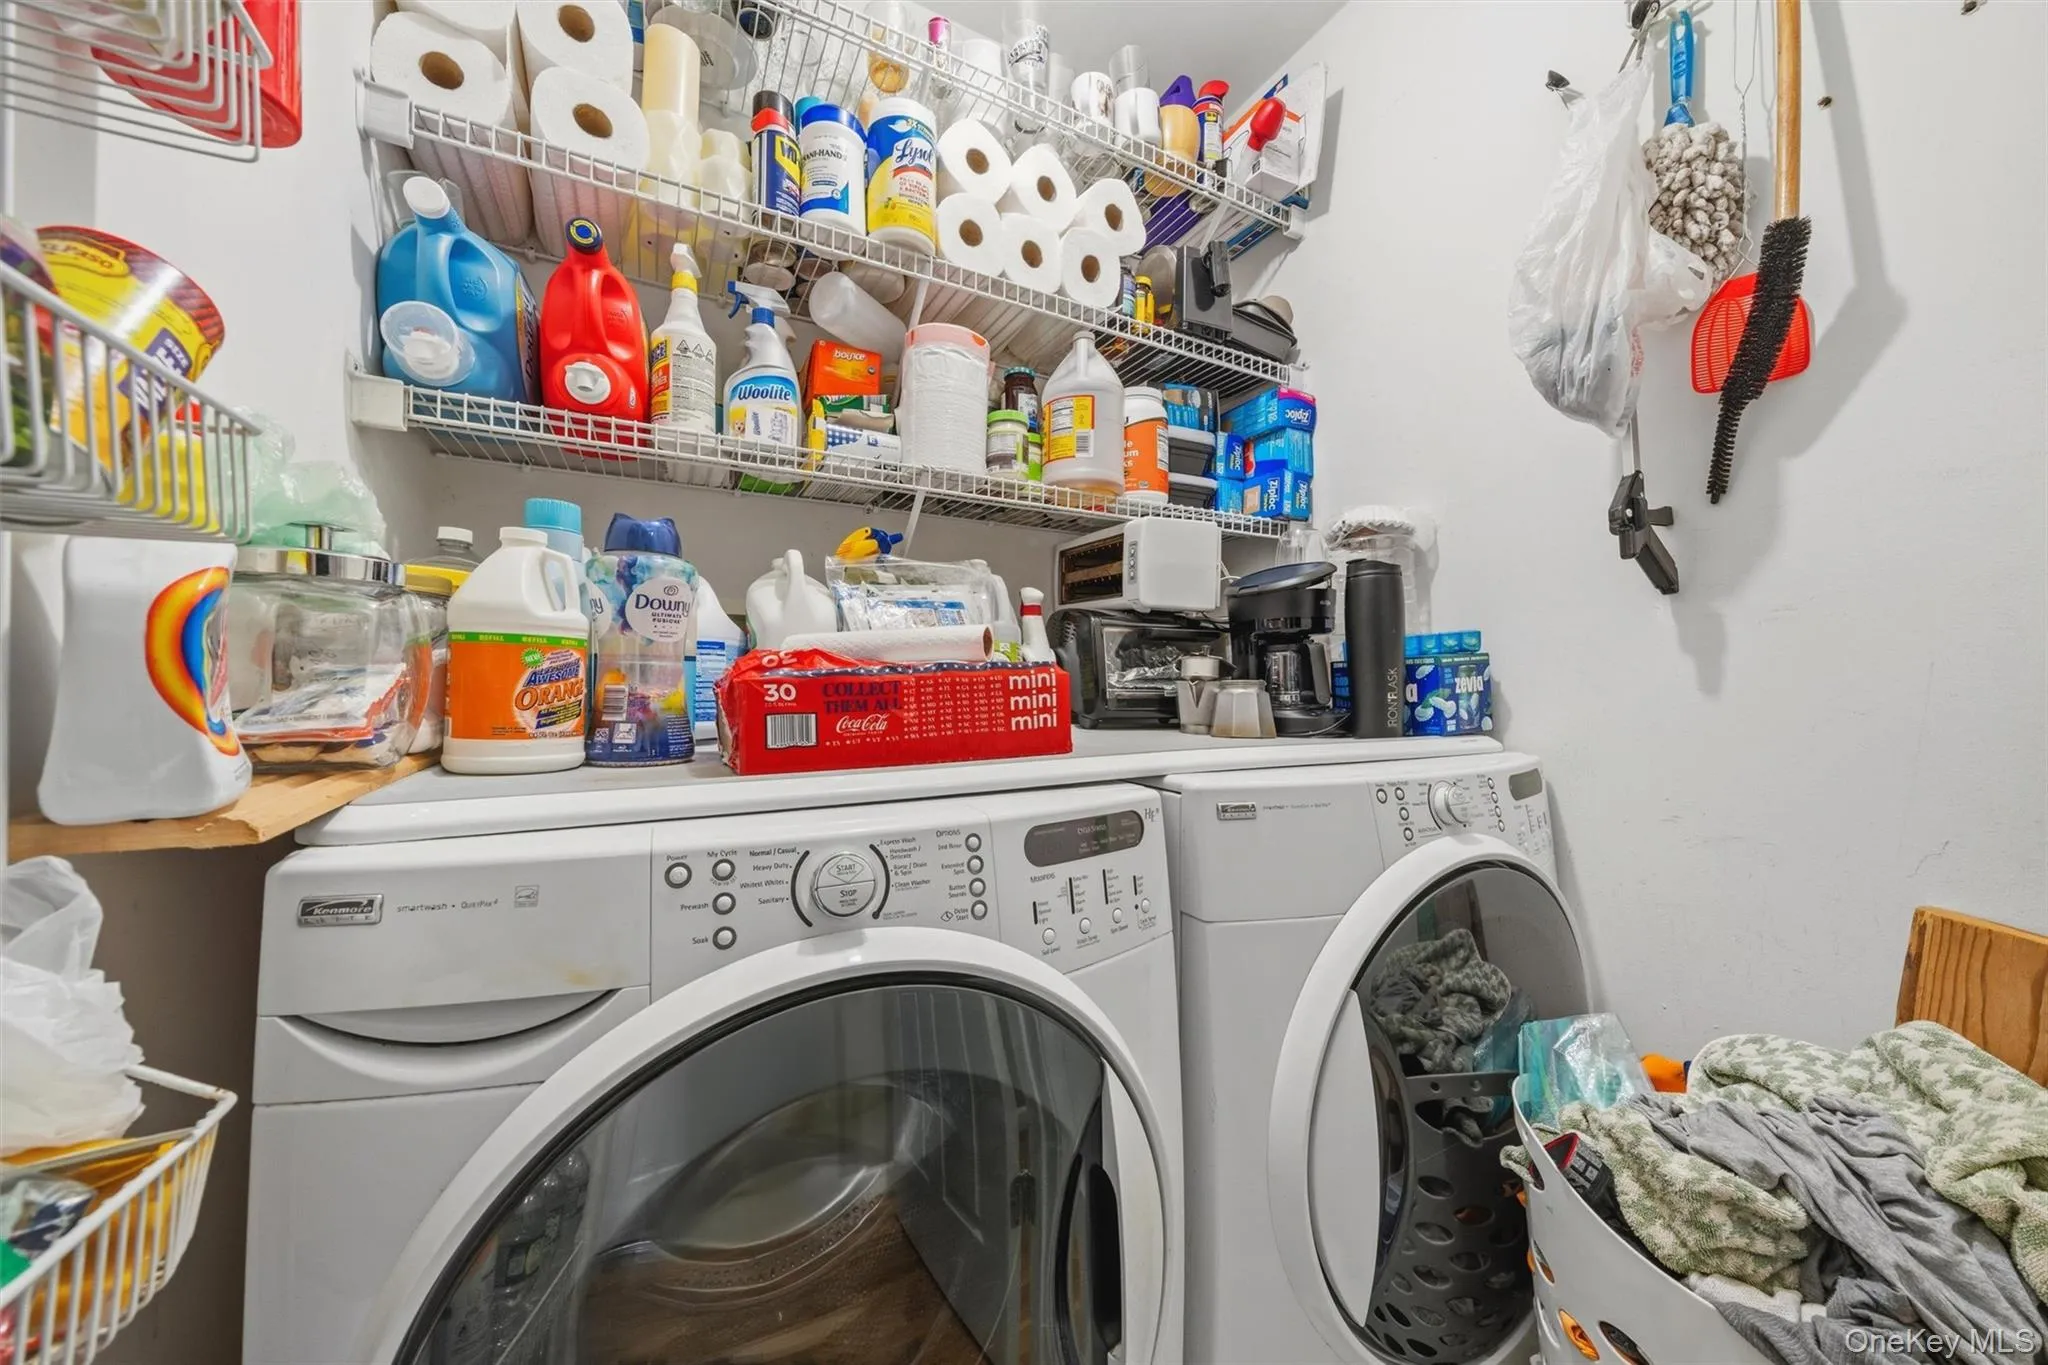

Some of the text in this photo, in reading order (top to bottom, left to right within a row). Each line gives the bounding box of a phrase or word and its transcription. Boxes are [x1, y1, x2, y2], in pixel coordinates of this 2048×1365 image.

[895, 138, 933, 165] Lysol
[833, 350, 866, 361] bounce
[738, 385, 791, 401] Woolite
[1285, 408, 1309, 424] Ziploc
[1267, 479, 1278, 511] Ziploc
[634, 593, 690, 618] Downy
[1009, 668, 1057, 690] mini
[1455, 676, 1484, 694] zevia
[763, 683, 797, 702] 30
[822, 681, 901, 697] COLLECT
[824, 697, 902, 714] THEM ALL
[1010, 688, 1057, 711] mini
[1011, 708, 1057, 731] mini
[719, 849, 738, 858] Cycle
[777, 846, 797, 855] Casual
[666, 854, 688, 862] Power
[752, 863, 789, 872] Heavy Duty
[836, 863, 856, 872] START
[740, 881, 763, 889] Whitest
[764, 879, 785, 887] Whites
[840, 889, 857, 898] STOP
[680, 902, 709, 911] Prewash
[758, 896, 785, 905] Sanitary
[313, 904, 372, 916] Kenmore
[397, 903, 448, 913] smartwash
[692, 936, 709, 945] Soak
